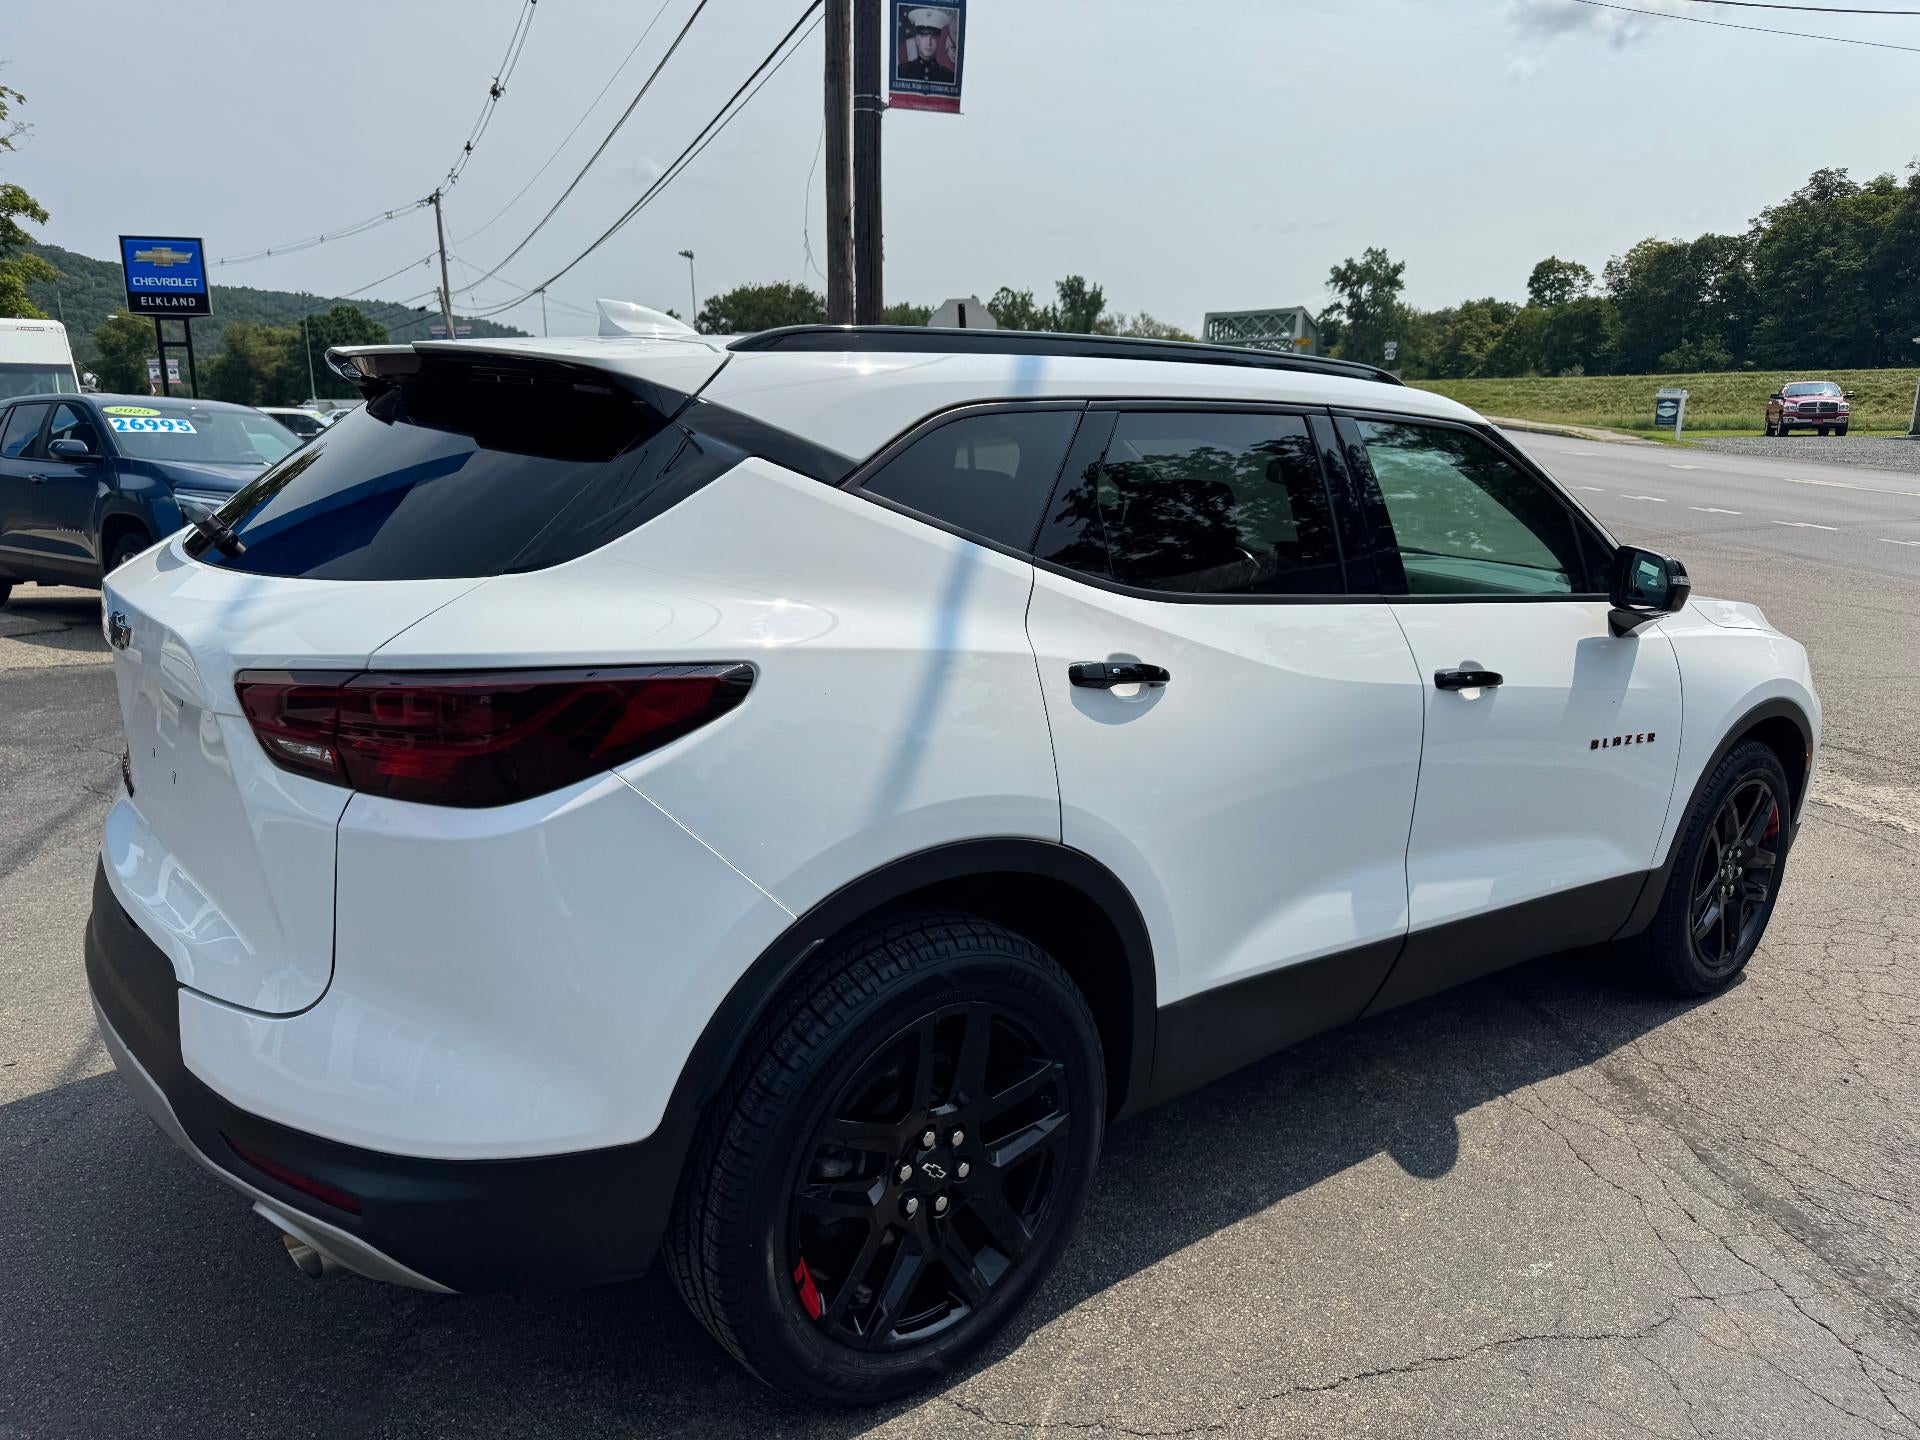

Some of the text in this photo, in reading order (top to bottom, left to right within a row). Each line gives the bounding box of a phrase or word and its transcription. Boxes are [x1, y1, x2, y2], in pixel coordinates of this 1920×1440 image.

[132, 276, 199, 287] CHEVROLET
[140, 296, 196, 307] ELKLAND
[114, 407, 151, 415] 2025
[112, 418, 191, 432] 26995
[1590, 732, 1656, 750] BLAZER
